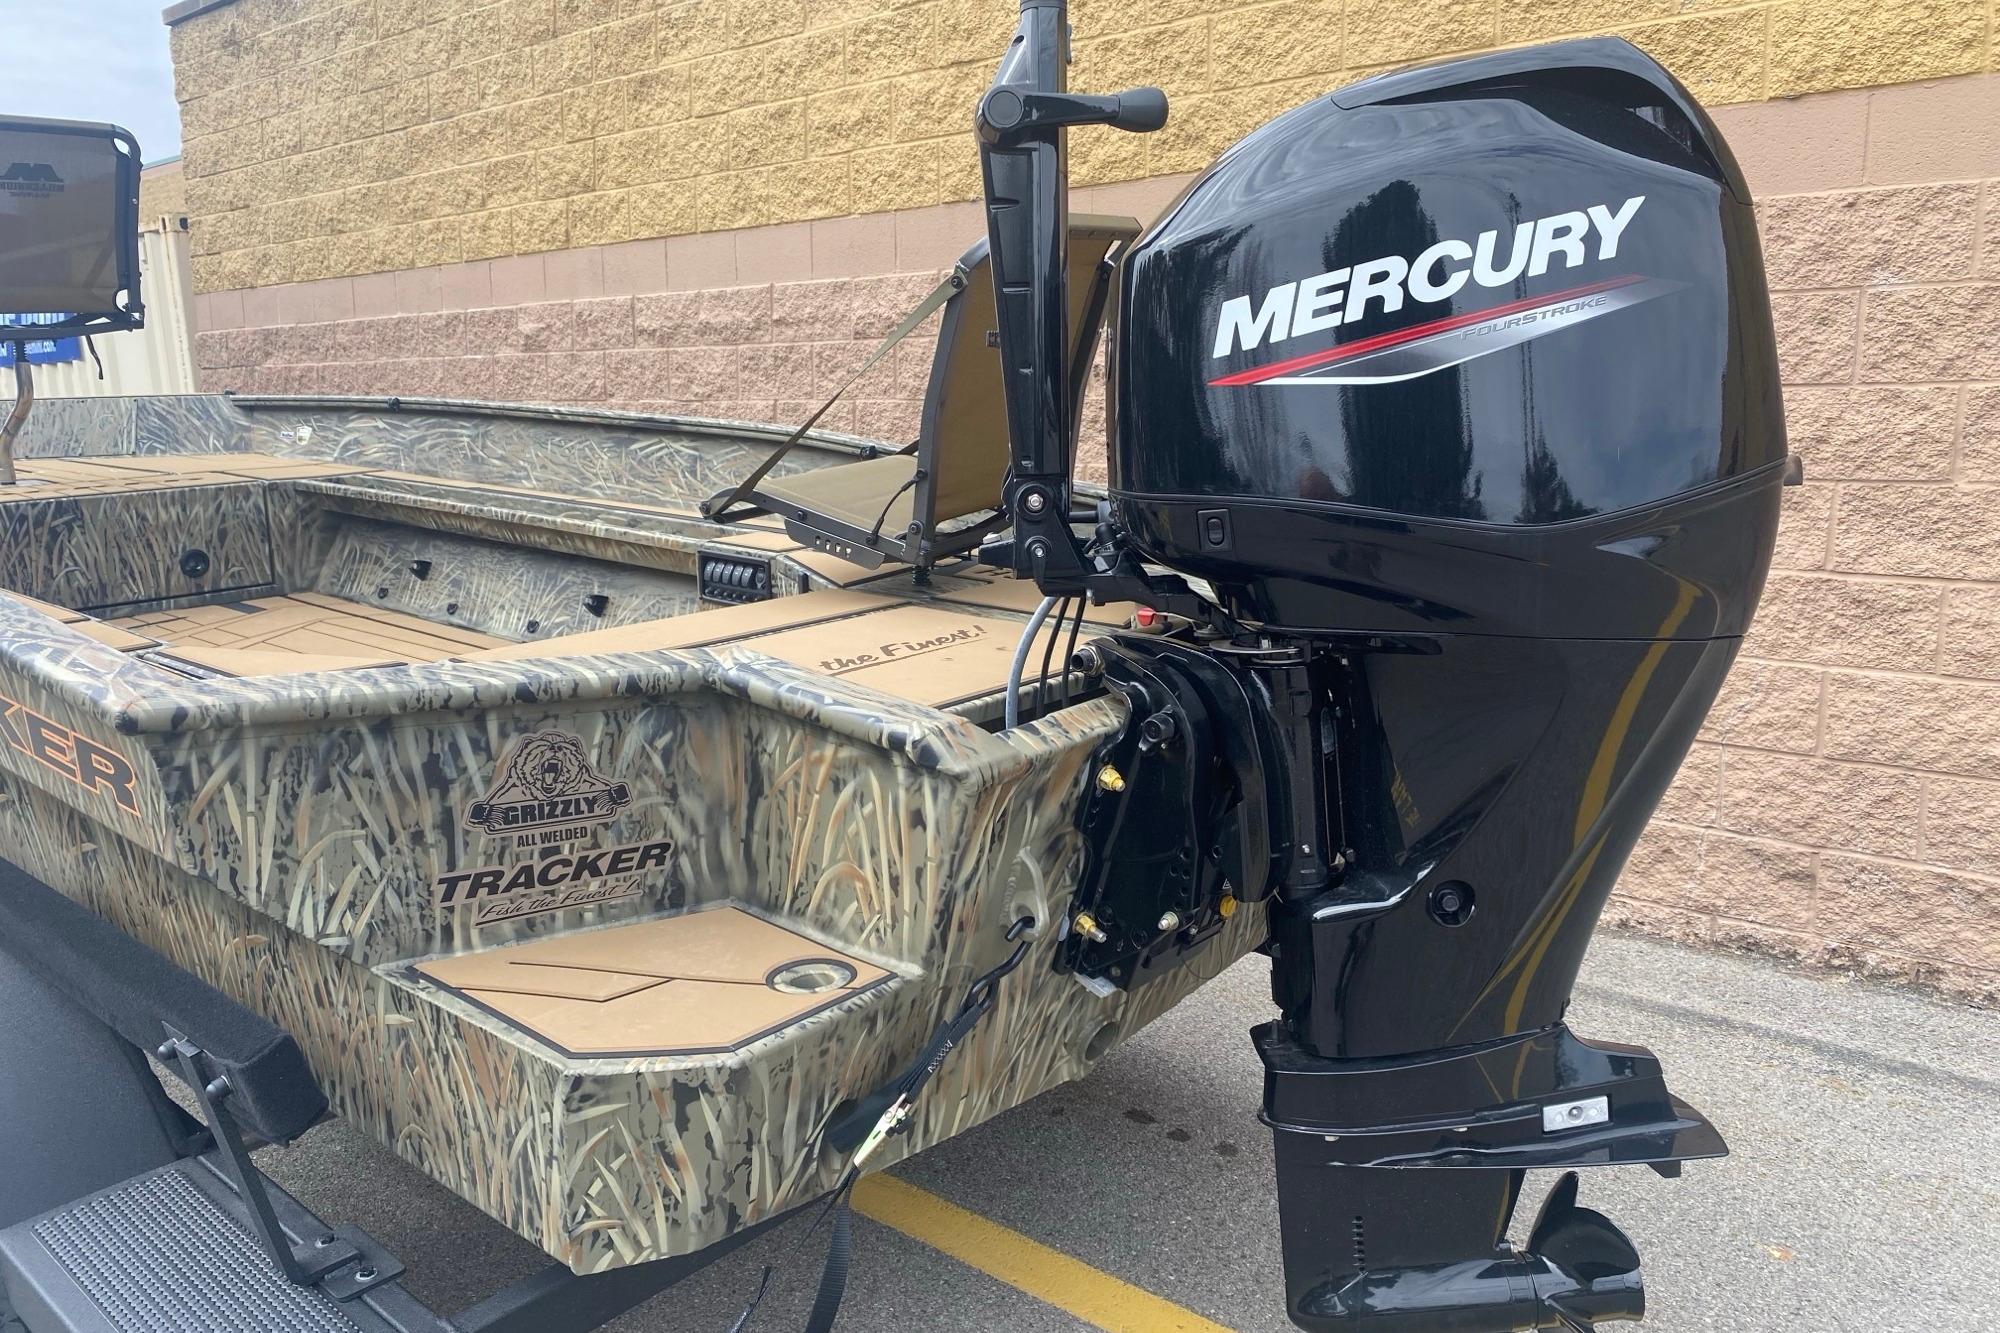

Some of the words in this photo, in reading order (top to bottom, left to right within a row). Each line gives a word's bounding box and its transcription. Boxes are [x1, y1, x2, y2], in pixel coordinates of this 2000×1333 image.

[1212, 195, 1647, 359] MERCURY
[1460, 295, 1609, 341] FOURSTROKE
[818, 654, 880, 672] the
[879, 625, 988, 657] Finest!
[502, 796, 597, 826] GRIZZLY
[516, 833, 538, 848] ALL
[539, 826, 588, 845] WELDED
[436, 842, 672, 904] TRACKER
[480, 902, 525, 919] Fish
[528, 896, 558, 911] the
